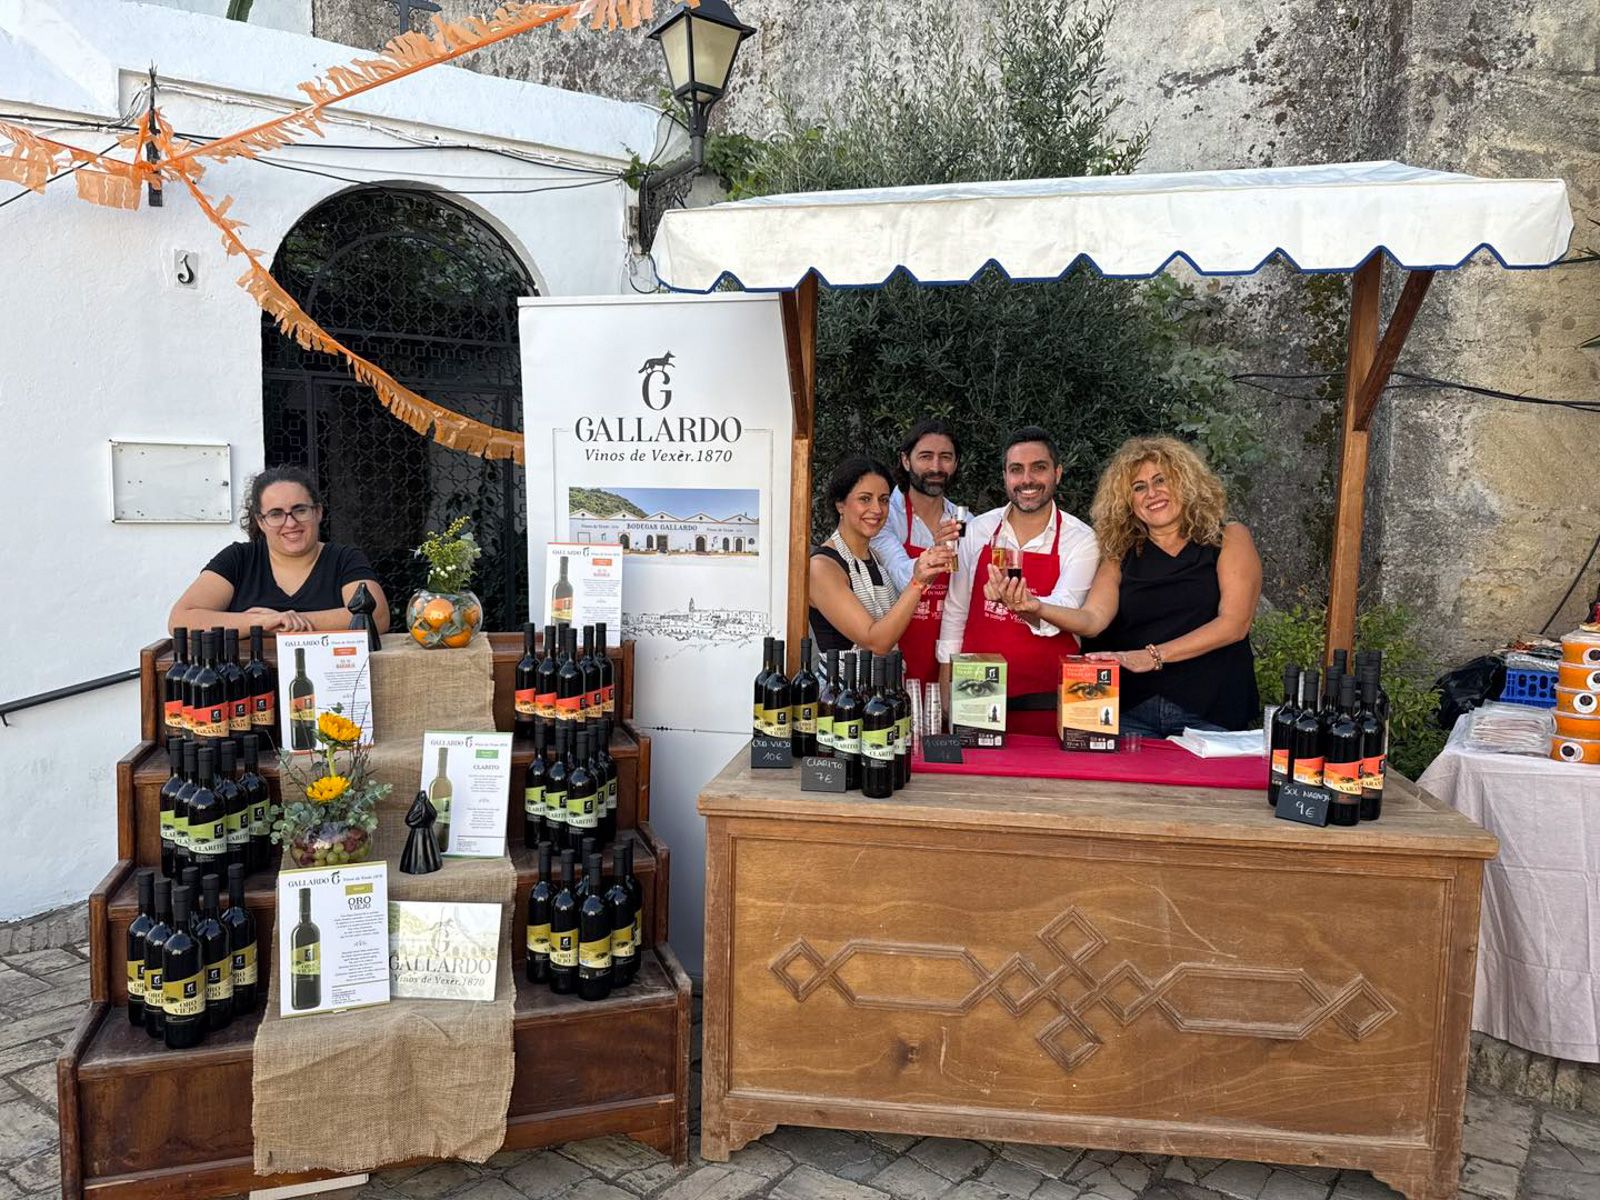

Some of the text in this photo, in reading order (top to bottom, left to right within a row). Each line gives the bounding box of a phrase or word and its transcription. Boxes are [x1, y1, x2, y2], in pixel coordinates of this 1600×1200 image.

[575, 416, 742, 443] GALLARDO
[585, 449, 625, 462] Vinos
[630, 449, 646, 462] de
[762, 752, 782, 761] 10€
[806, 758, 843, 769] CLARITO
[815, 772, 833, 783] 7€
[1284, 785, 1299, 797] SOL
[1295, 800, 1316, 817] 9€
[288, 877, 330, 888] GALLARDO
[347, 895, 372, 906] ORO
[348, 903, 371, 911] VIEJO
[389, 954, 491, 975] GALLARDO
